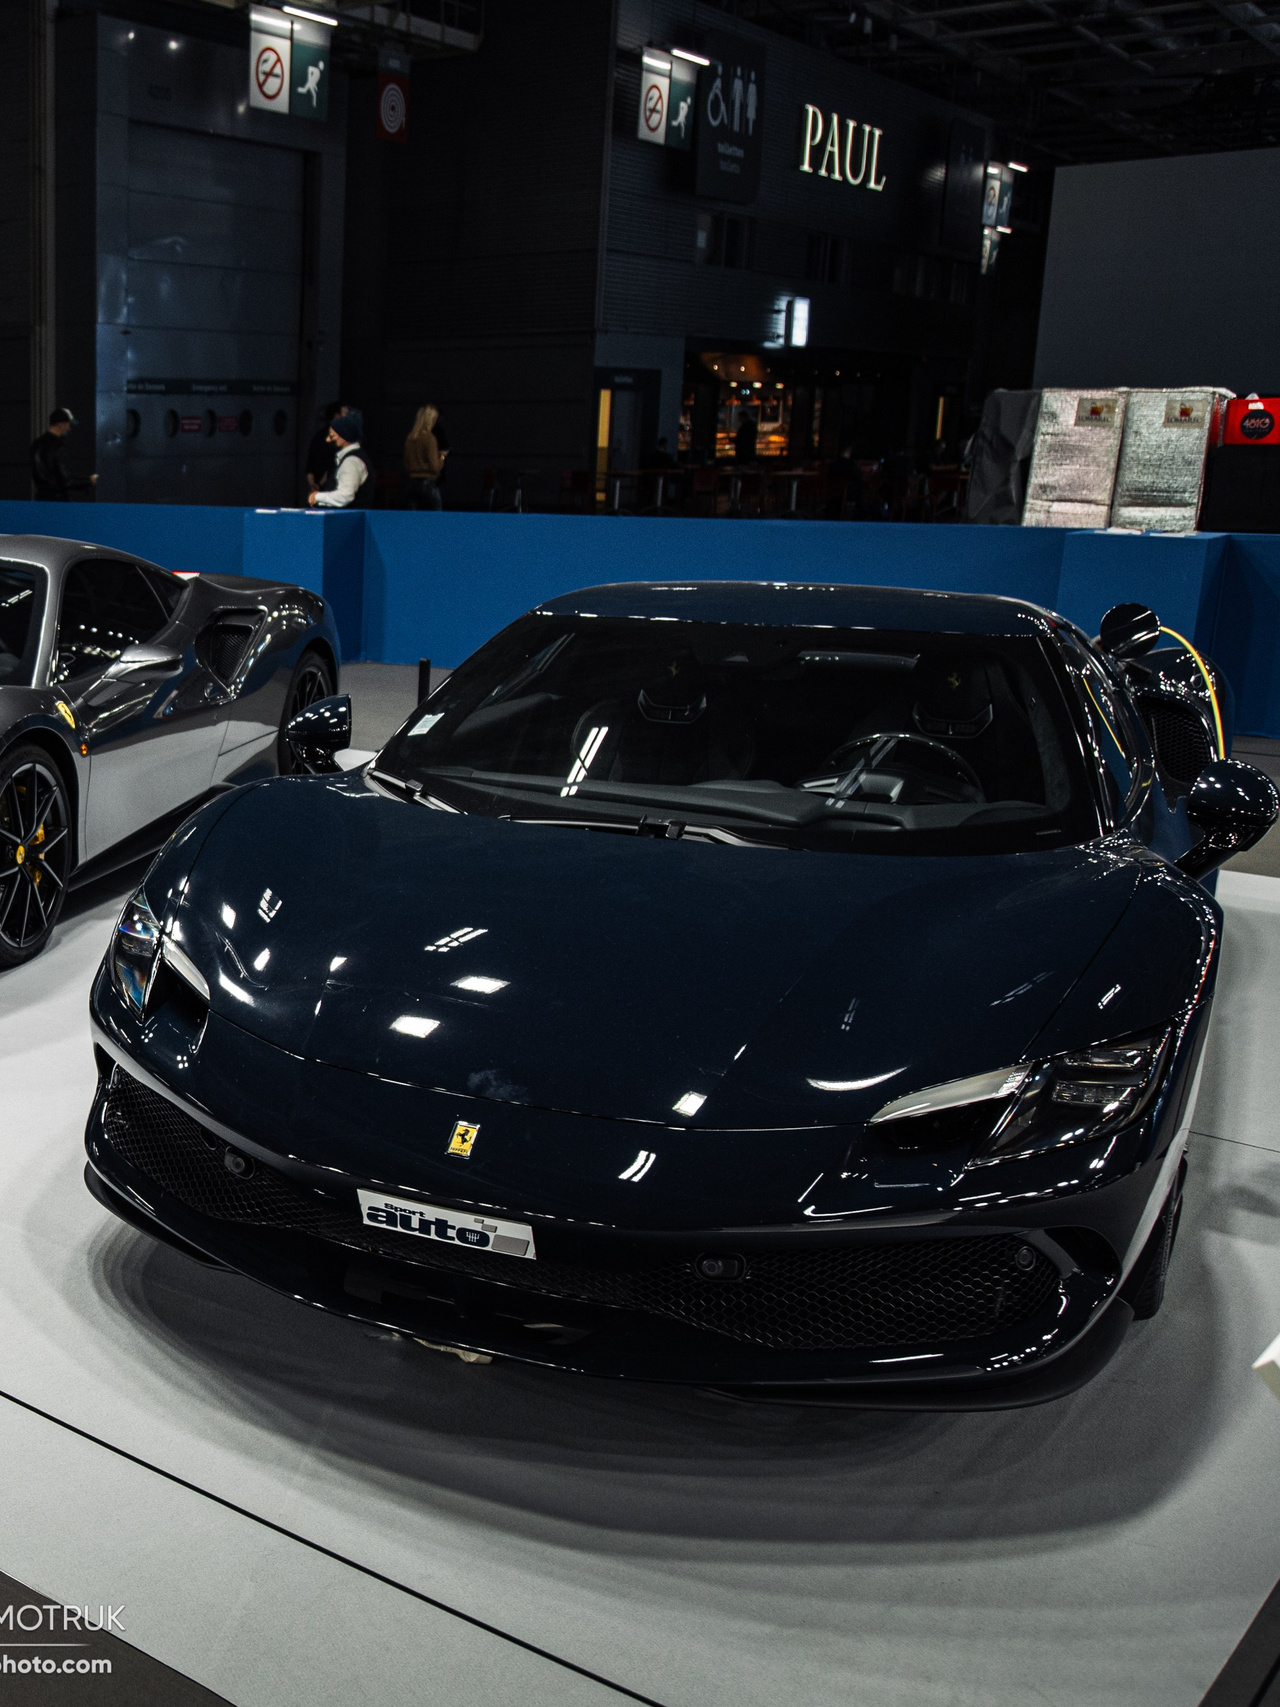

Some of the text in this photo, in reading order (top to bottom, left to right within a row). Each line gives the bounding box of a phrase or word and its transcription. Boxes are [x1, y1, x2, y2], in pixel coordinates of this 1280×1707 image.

[799, 103, 887, 192] PAUL
[366, 1206, 490, 1248] auto
[384, 1202, 426, 1218] Sport
